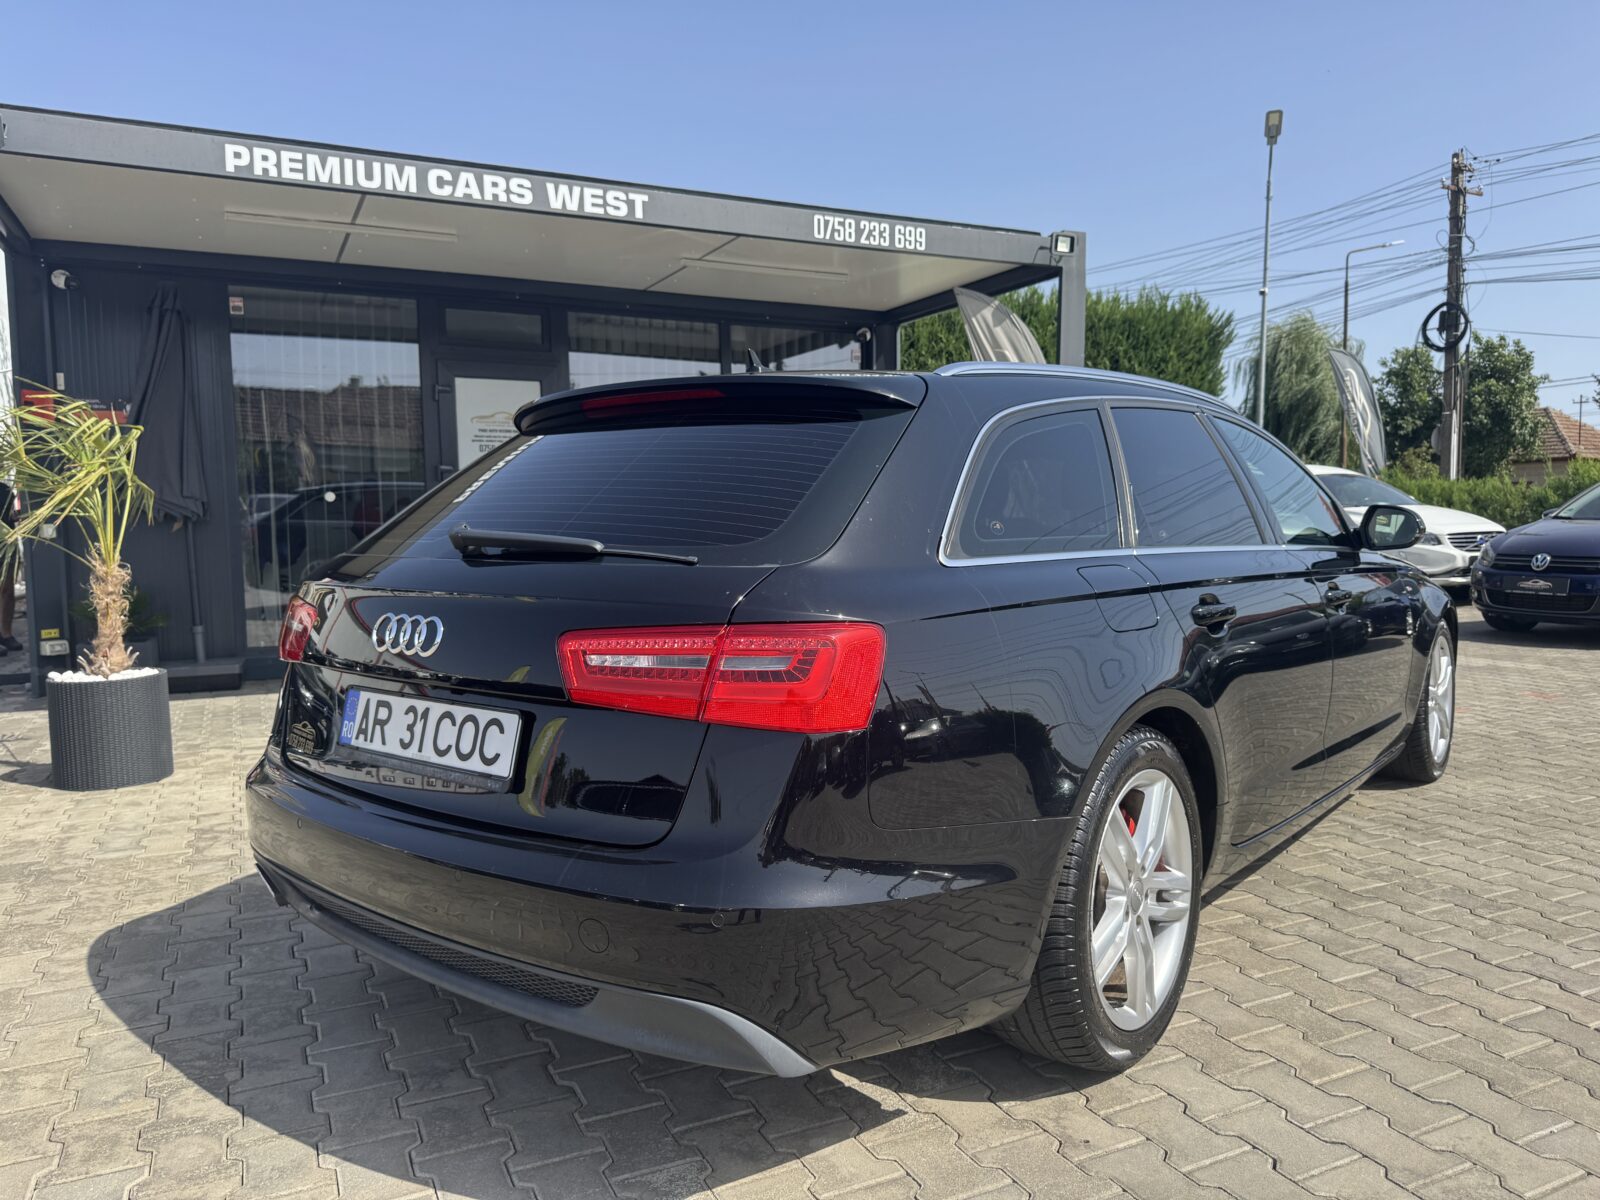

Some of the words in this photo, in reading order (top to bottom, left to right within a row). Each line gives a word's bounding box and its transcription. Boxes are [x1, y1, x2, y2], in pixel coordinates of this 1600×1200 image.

[224, 143, 418, 193] PREMIUM
[427, 168, 533, 205] CARS
[545, 182, 649, 219] WEST
[813, 214, 856, 242] 0758
[860, 220, 890, 247] 233
[894, 224, 926, 251] 699
[342, 720, 354, 738] RO
[355, 697, 393, 746] AR
